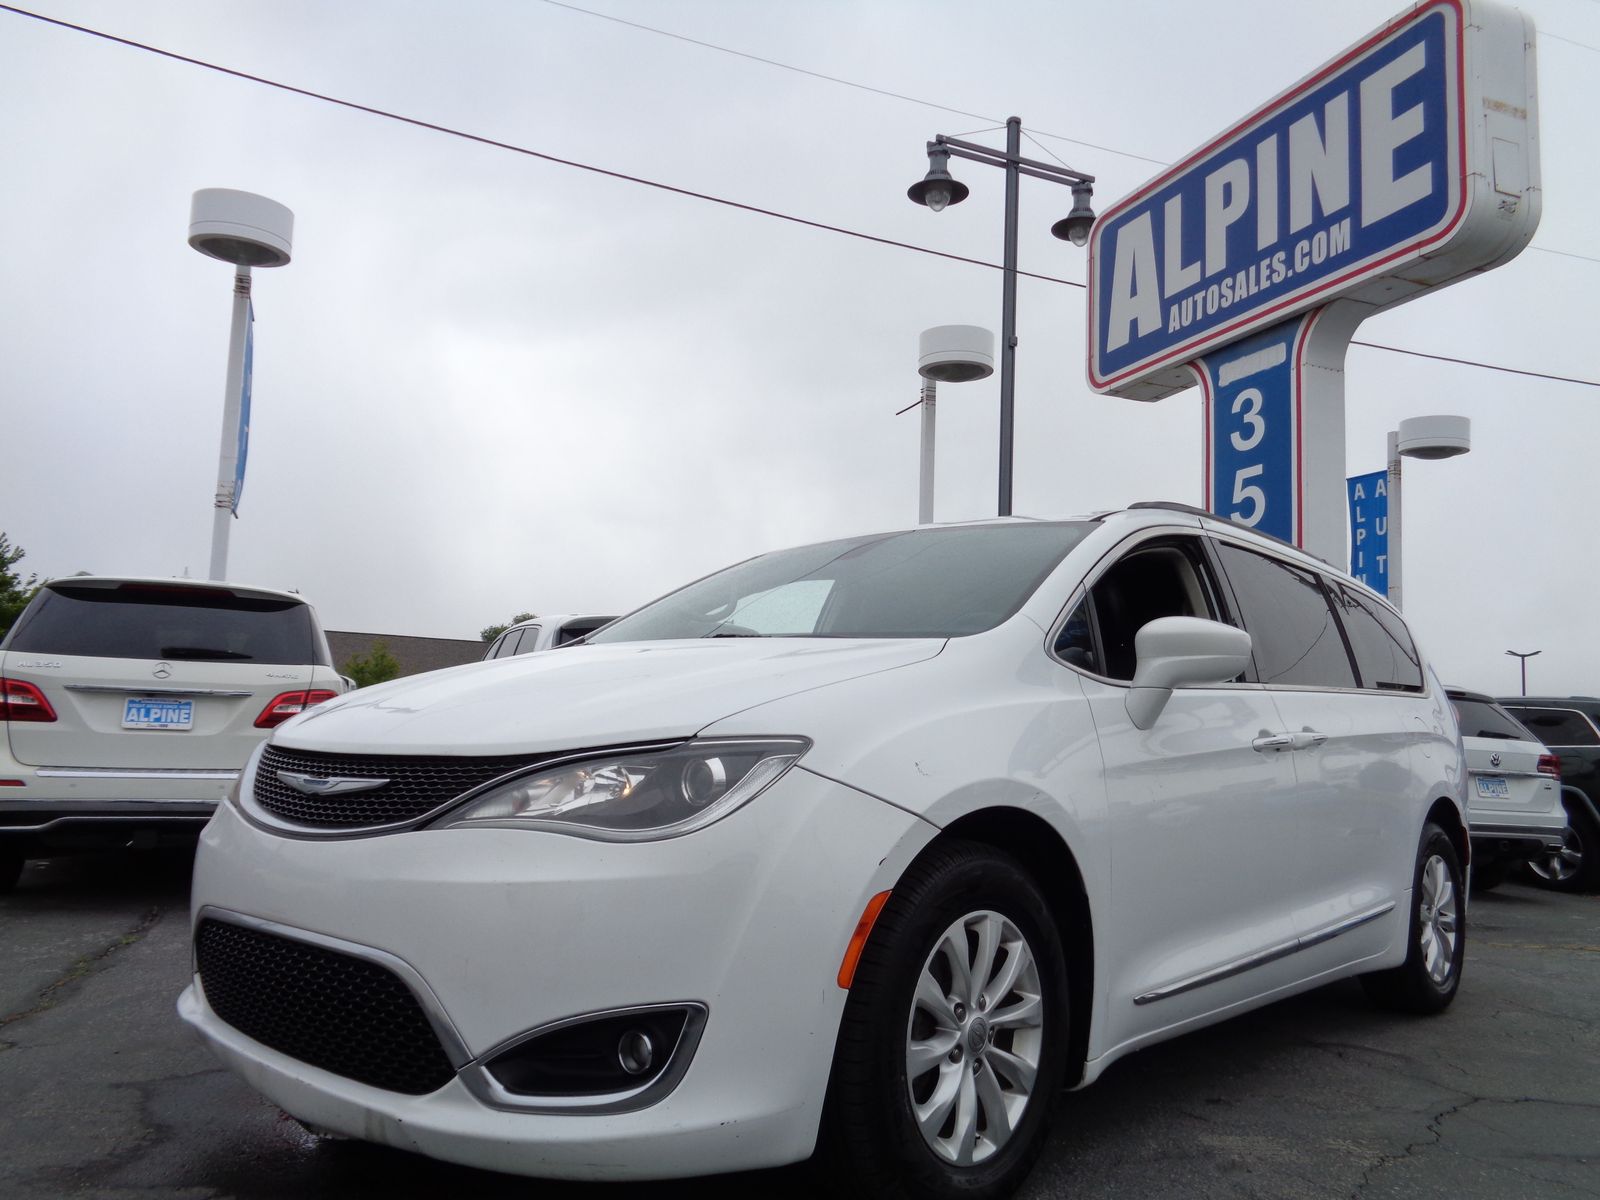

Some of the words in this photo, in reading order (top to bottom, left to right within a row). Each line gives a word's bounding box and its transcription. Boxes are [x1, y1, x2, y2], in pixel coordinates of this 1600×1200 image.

[1107, 40, 1432, 353] ALPINE
[1168, 218, 1351, 334] AUTOSALES.COM
[1375, 479, 1388, 597] AUT
[127, 708, 190, 723] ALPINE
[1480, 783, 1508, 794] ALPINE
